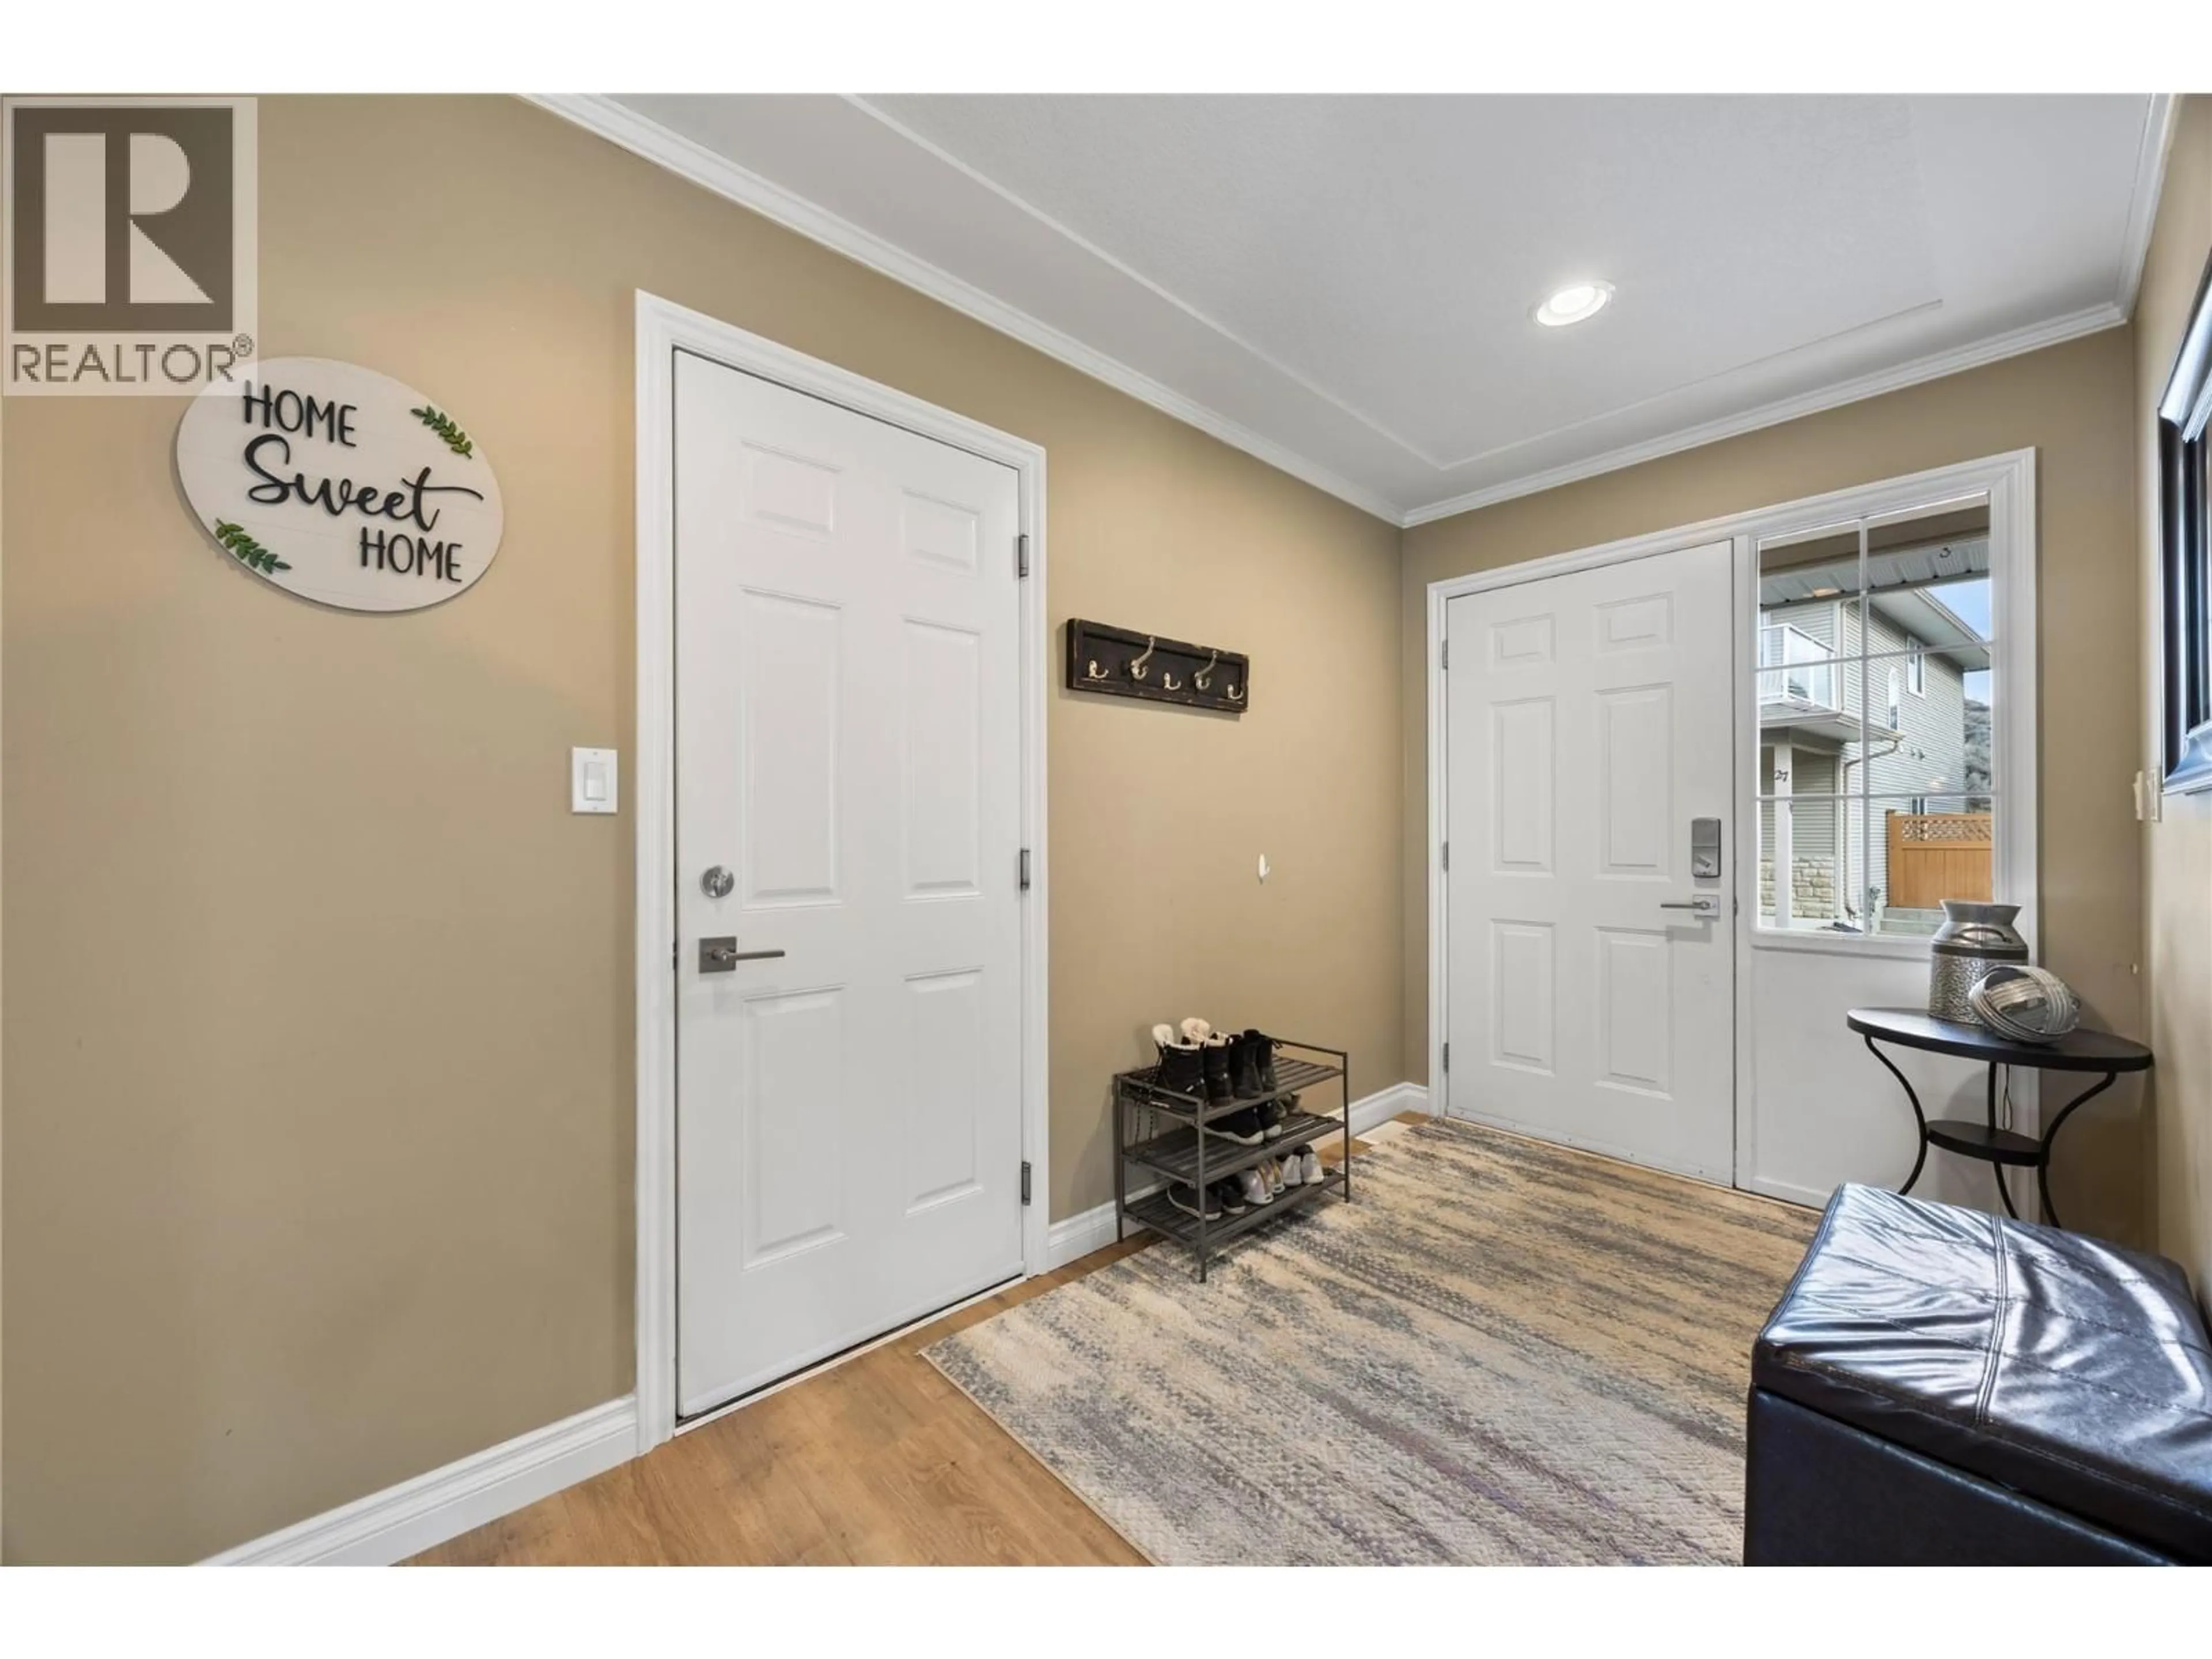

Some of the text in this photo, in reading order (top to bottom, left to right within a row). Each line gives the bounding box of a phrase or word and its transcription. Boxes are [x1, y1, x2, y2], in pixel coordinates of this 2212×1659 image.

[243, 380, 357, 447] HOME
[244, 434, 484, 531] Sweet
[359, 527, 463, 583] HOME
